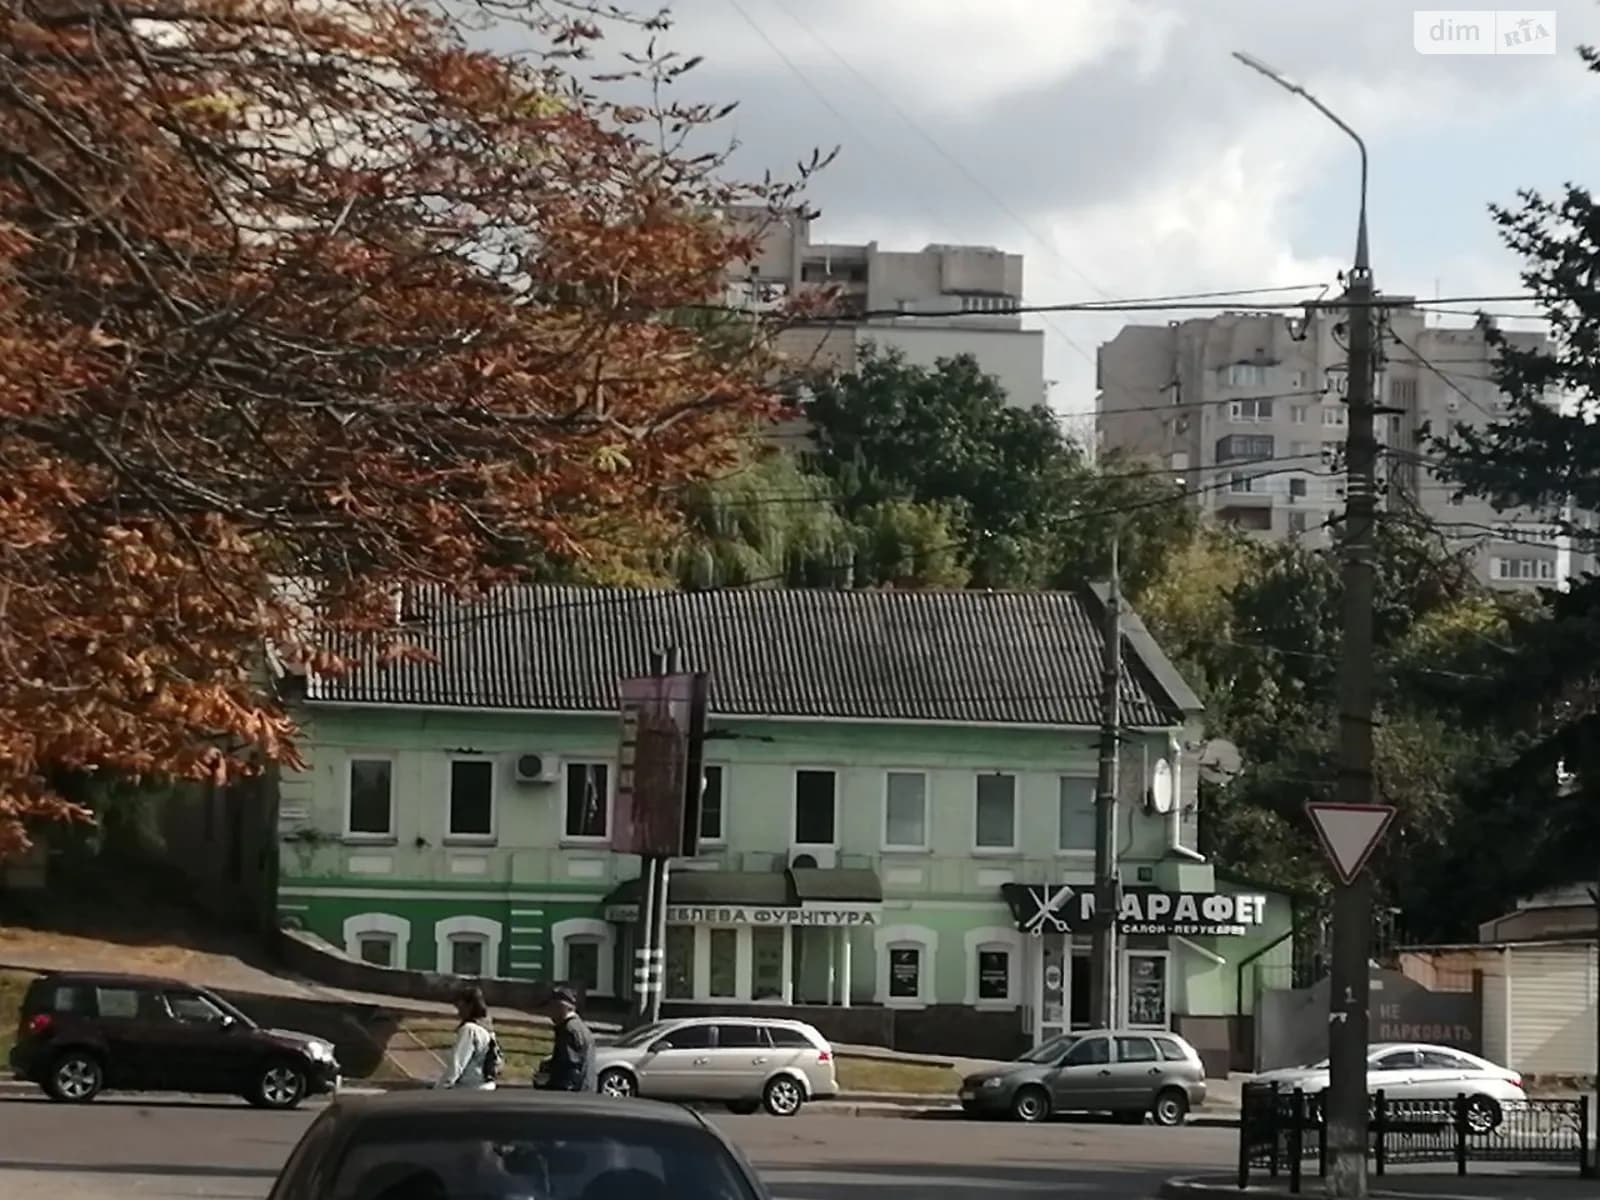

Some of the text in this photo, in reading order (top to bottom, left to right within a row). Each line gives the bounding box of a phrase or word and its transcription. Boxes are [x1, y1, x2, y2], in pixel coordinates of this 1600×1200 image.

[666, 906, 876, 925] ЕБЛЕВА ФУРНІТУРА
[1379, 1003, 1401, 1020] НЕ
[1379, 1023, 1473, 1041] ПАРКОВАТЬ
